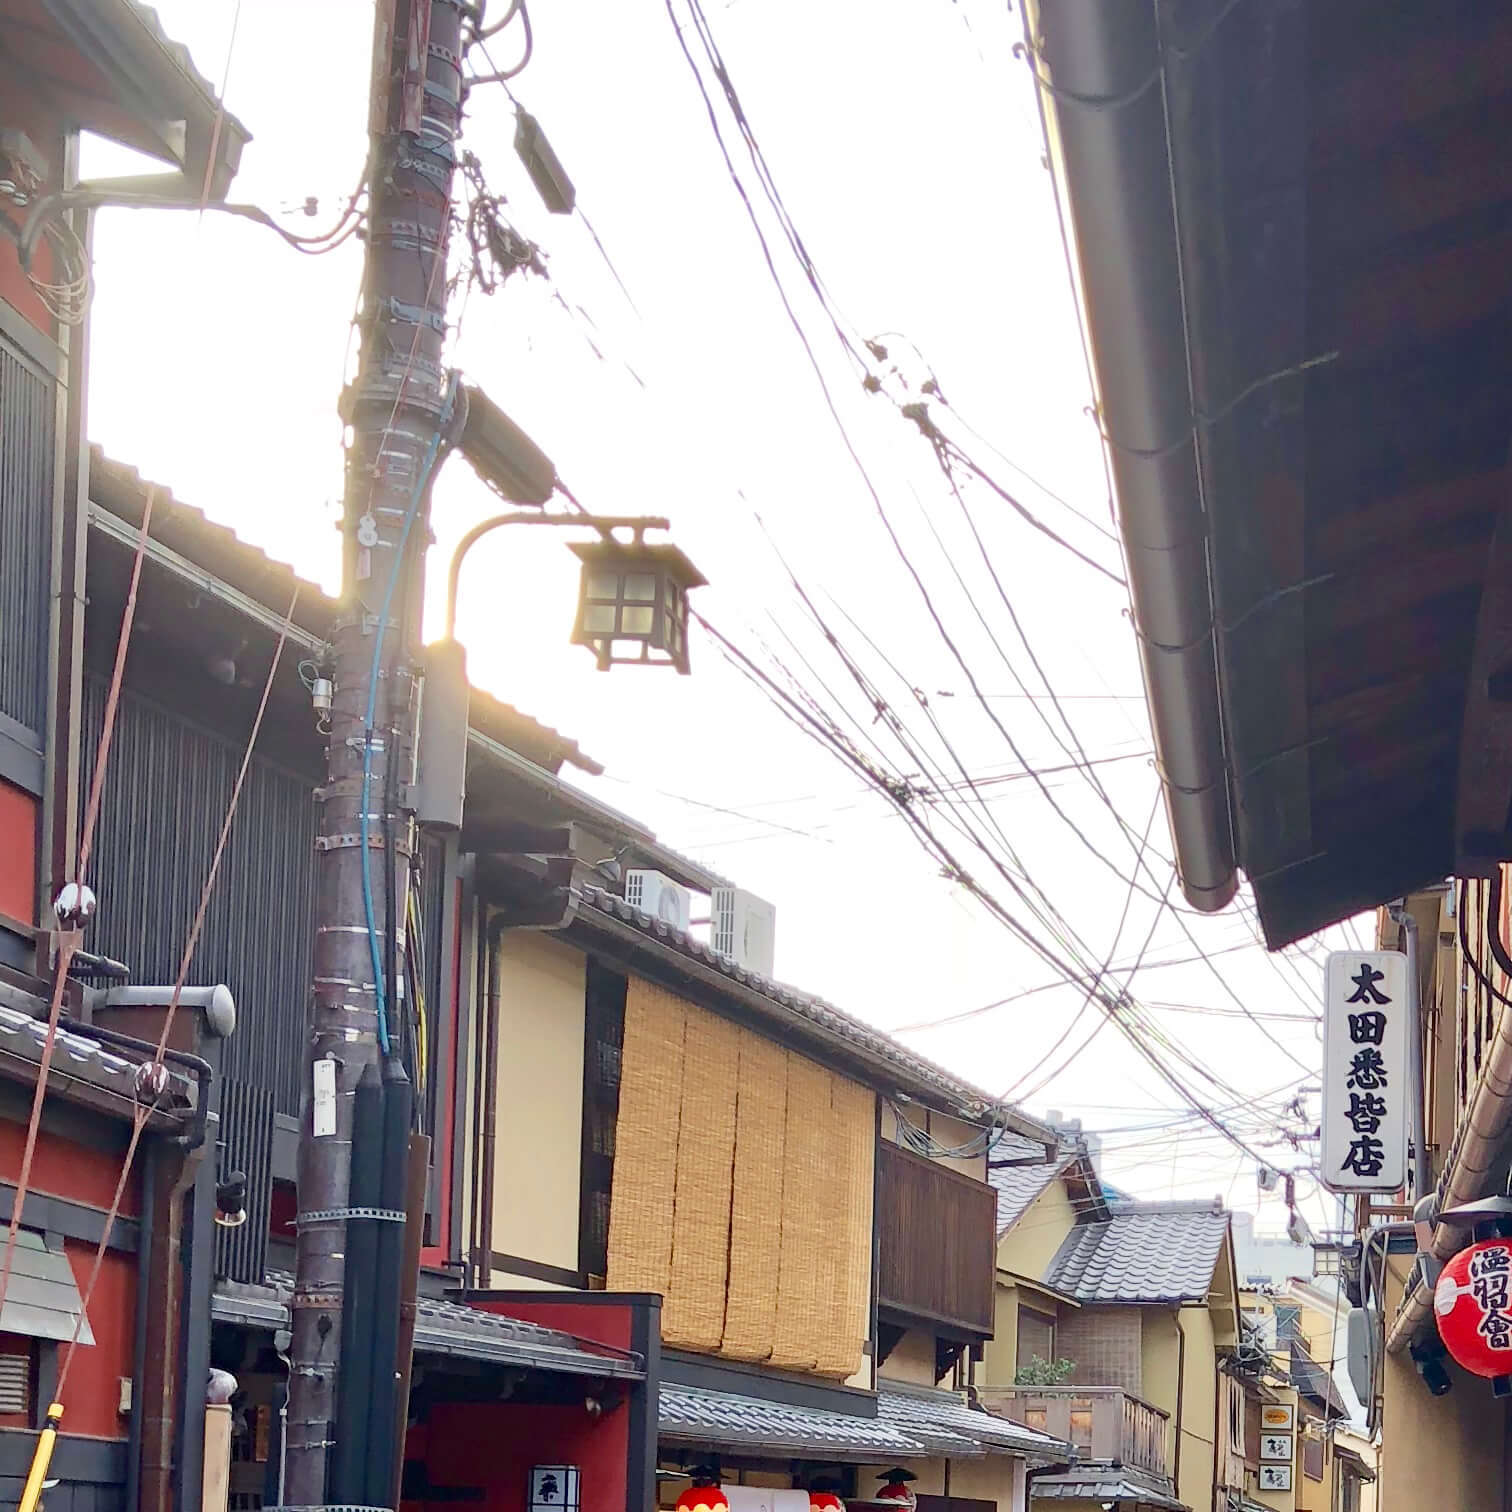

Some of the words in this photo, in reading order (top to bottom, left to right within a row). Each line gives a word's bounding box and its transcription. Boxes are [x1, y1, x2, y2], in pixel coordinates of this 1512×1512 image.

[1341, 964, 1393, 1177] 太田悉皆店
